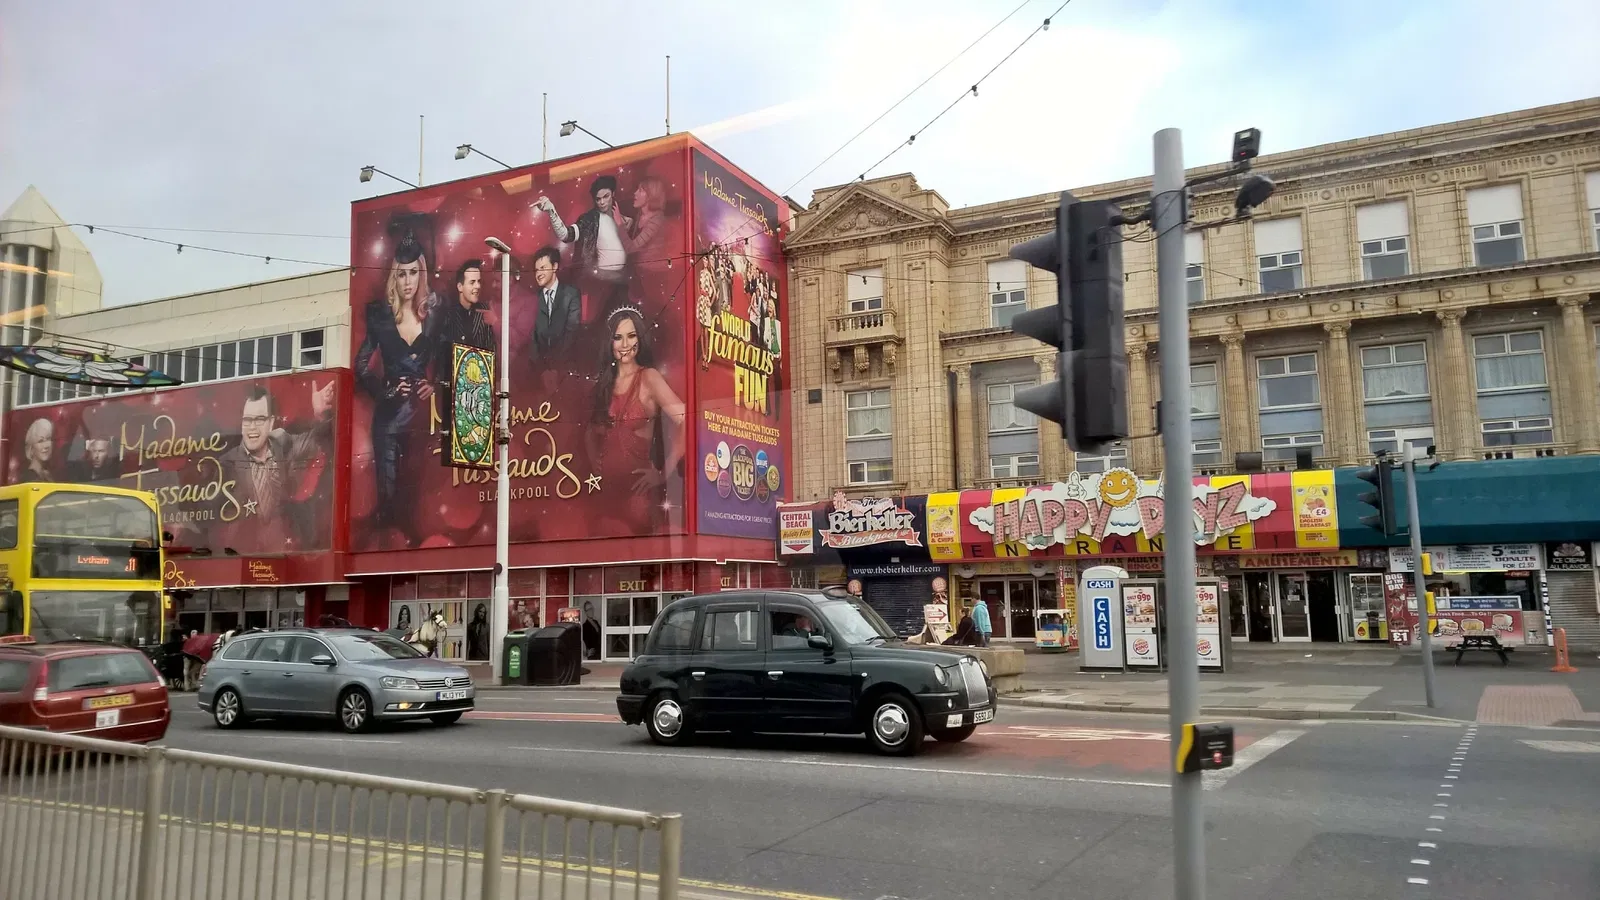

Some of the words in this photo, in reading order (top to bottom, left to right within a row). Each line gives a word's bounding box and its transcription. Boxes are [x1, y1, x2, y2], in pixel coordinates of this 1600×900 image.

[704, 170, 737, 208] Madame
[735, 193, 771, 235] Tussauds
[721, 310, 751, 342] WORLD
[708, 314, 774, 375] famous
[734, 364, 767, 415] FUN
[704, 411, 716, 420] BUY
[716, 413, 731, 425] YOUR
[731, 418, 761, 433] ATTRACTION
[761, 425, 780, 437] TICKETS
[119, 415, 227, 466] Madame
[708, 422, 721, 433] HERE
[722, 425, 728, 434] AT
[729, 427, 751, 440] MADAME
[752, 433, 777, 445] TUSSAUDS
[733, 462, 754, 487] BIG
[479, 486, 550, 502] BLAKPOOL
[862, 497, 879, 506] The
[163, 510, 215, 523] LACKPOOL
[782, 513, 811, 521] CENTRAL
[1136, 481, 1251, 540] DYZ
[828, 508, 914, 534] Bierkeller
[993, 499, 1112, 545] HAPPY
[838, 530, 899, 546] Blackpool
[1491, 546, 1503, 556] 5
[77, 555, 110, 564] Lytham
[1245, 555, 1350, 568] AMUSEMENTS
[852, 565, 941, 575] www.thebierkeller.com
[619, 580, 647, 591] EXIT
[720, 576, 731, 588] XIT
[1137, 593, 1151, 601] 99p
[1199, 593, 1214, 601] 99p
[1096, 601, 1108, 646] CASH
[1393, 632, 1408, 641] £1
